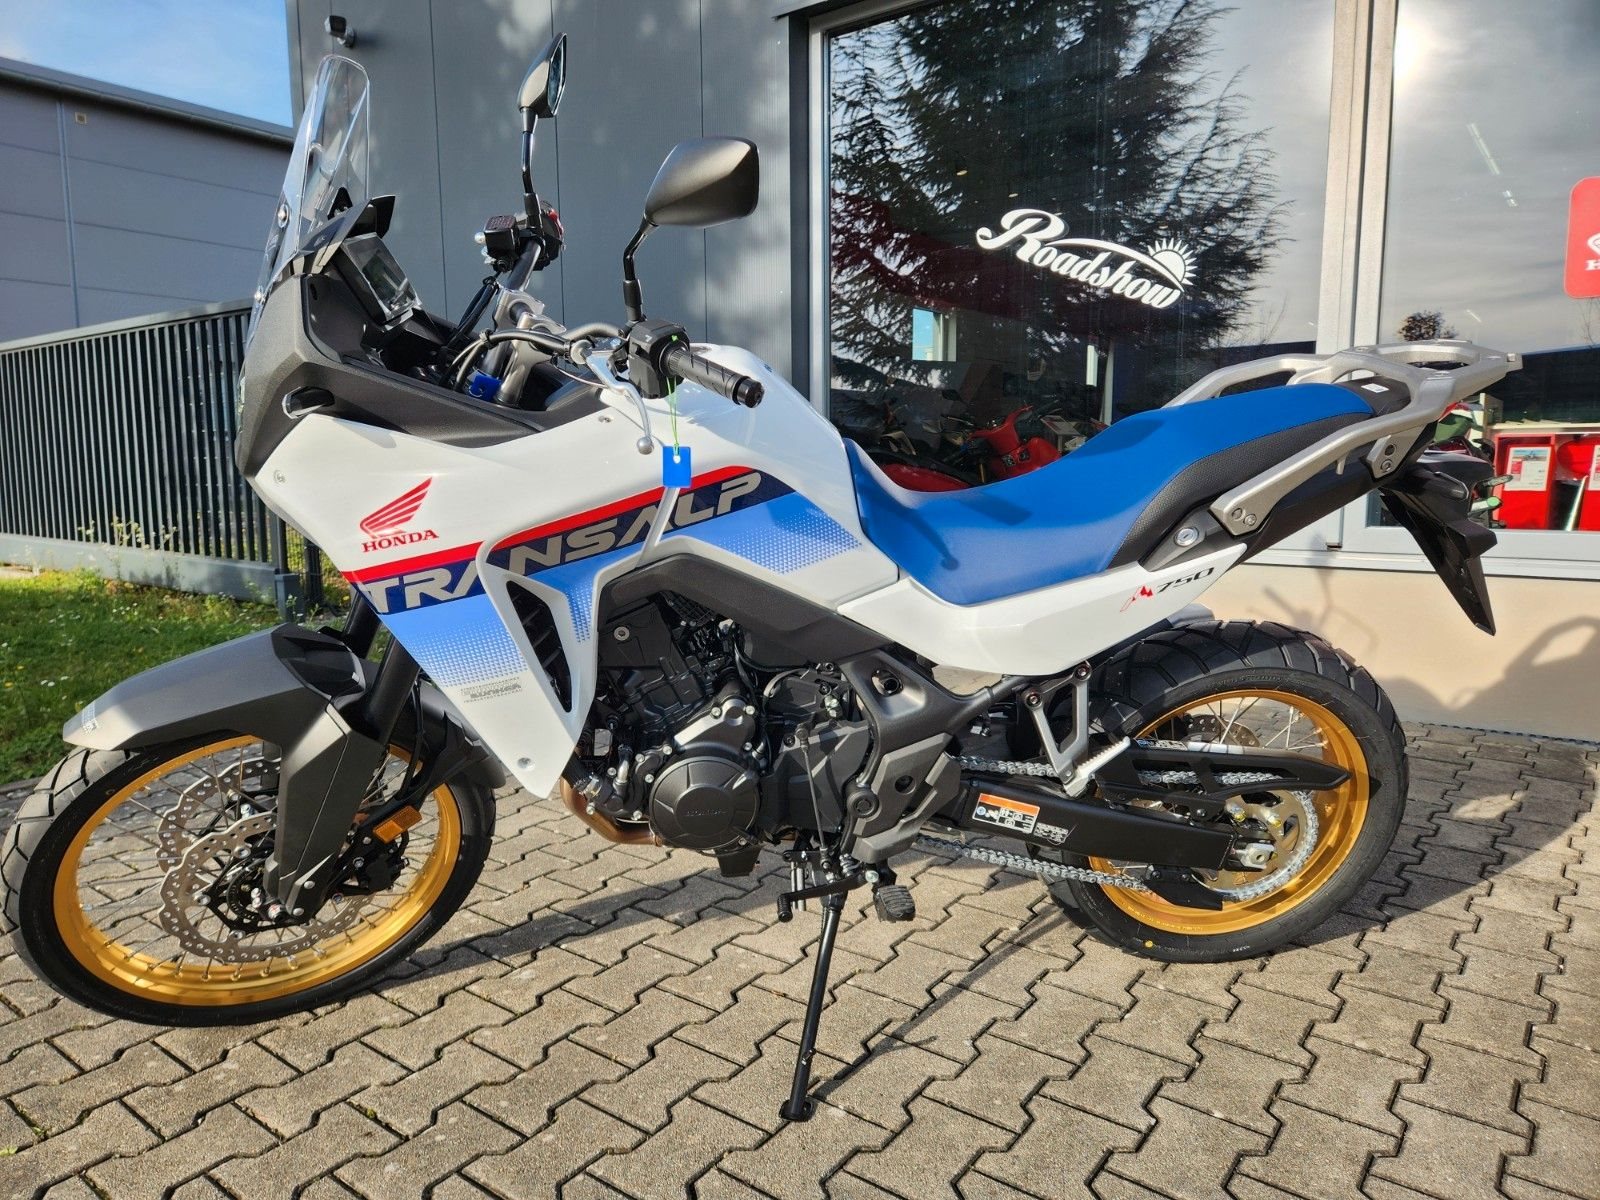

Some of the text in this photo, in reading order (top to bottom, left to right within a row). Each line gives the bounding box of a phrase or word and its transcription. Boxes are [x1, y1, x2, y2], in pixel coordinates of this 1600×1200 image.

[976, 208, 1182, 309] Roadshow
[362, 529, 440, 553] HONDA
[1157, 567, 1215, 594] 750
